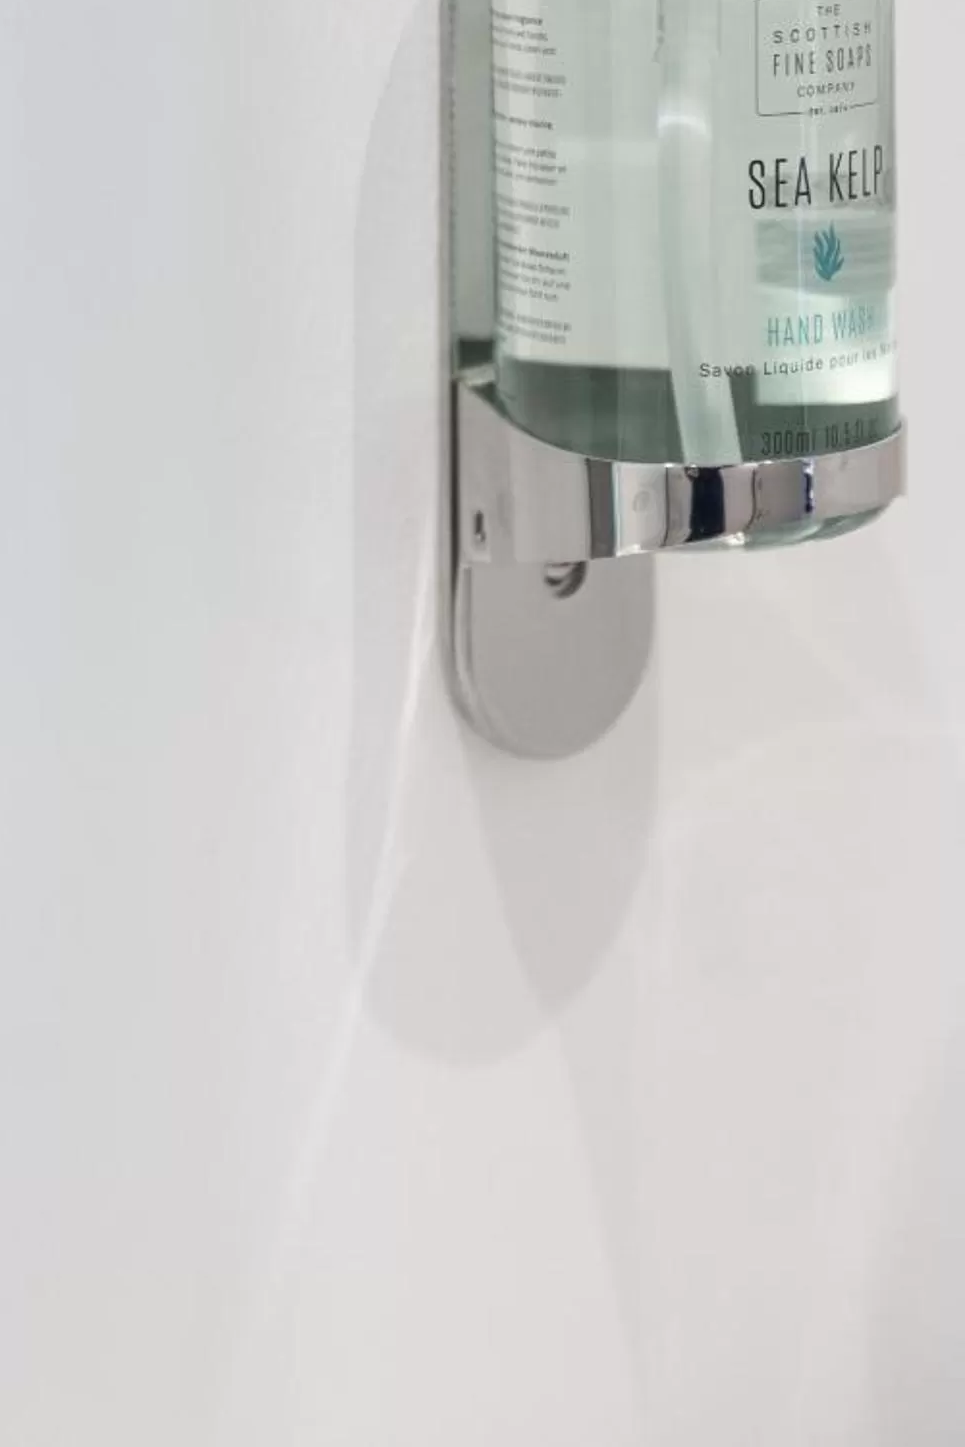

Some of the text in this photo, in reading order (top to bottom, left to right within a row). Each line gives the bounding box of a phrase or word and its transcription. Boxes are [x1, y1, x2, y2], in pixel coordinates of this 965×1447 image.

[816, 3, 842, 16] THE
[772, 21, 872, 44] SCOTTISH
[773, 43, 872, 77] FINE SOAPS
[796, 80, 855, 98] COMPANY
[748, 144, 884, 210] SEA KELP
[767, 305, 875, 347] HAND WASH
[699, 362, 756, 378] Savon
[763, 358, 824, 376] Liquide
[829, 353, 859, 371] pour
[760, 429, 817, 457] 300ml
